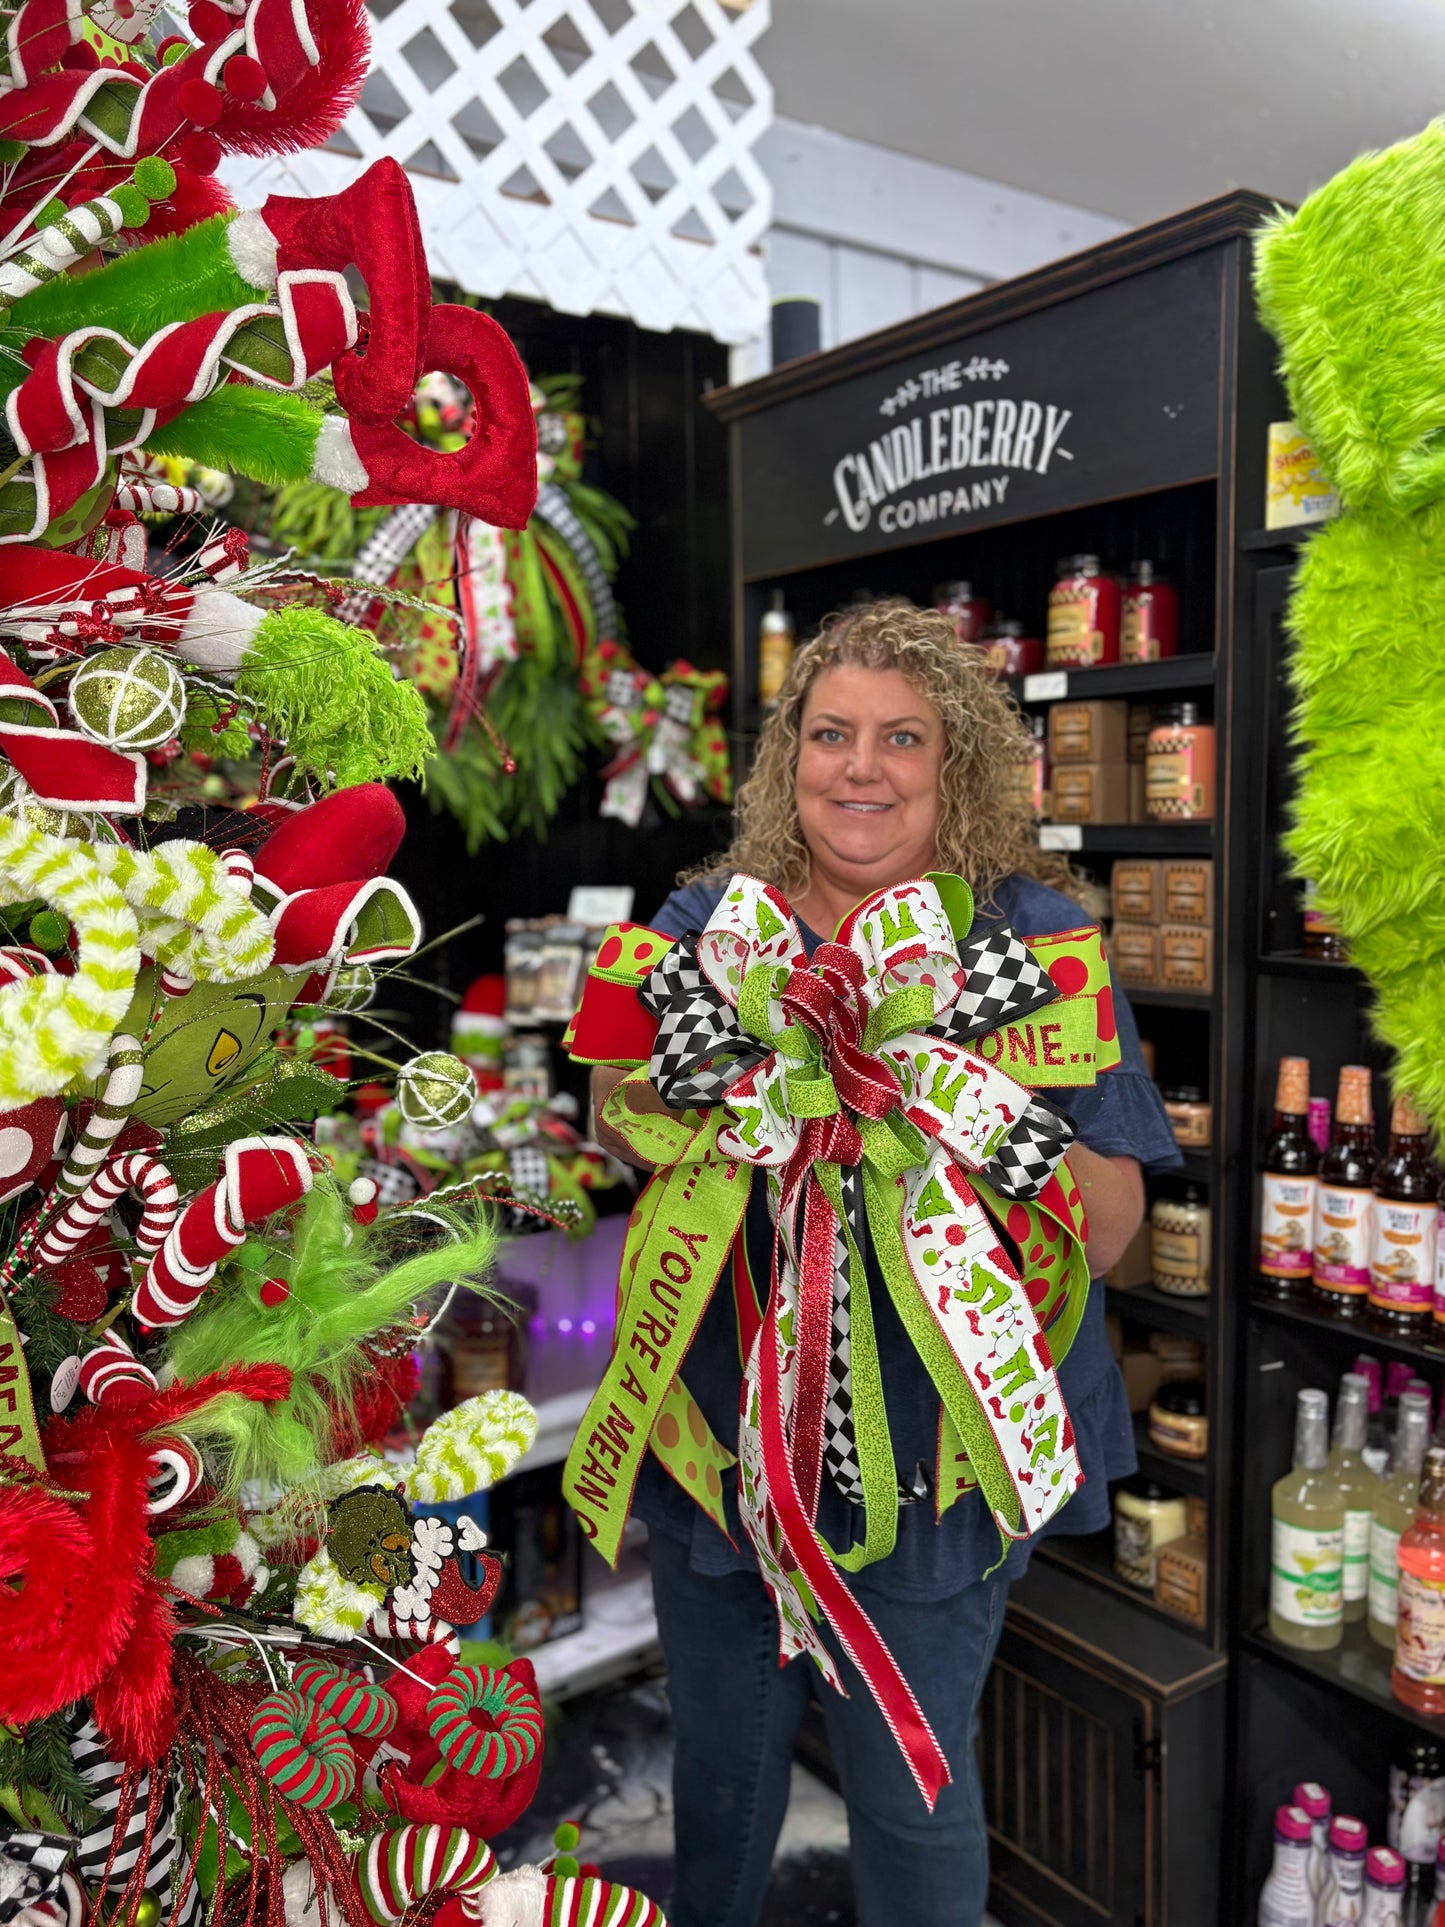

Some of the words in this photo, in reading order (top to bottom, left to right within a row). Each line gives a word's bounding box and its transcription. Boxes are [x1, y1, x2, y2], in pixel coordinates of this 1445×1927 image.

[918, 360, 963, 398] THE
[833, 399, 1072, 532] CANDLEBERRY
[878, 474, 1010, 533] COMPANY
[629, 1223, 708, 1374] YOU'RE
[619, 1361, 648, 1405] A
[573, 1401, 635, 1512] MEAN
